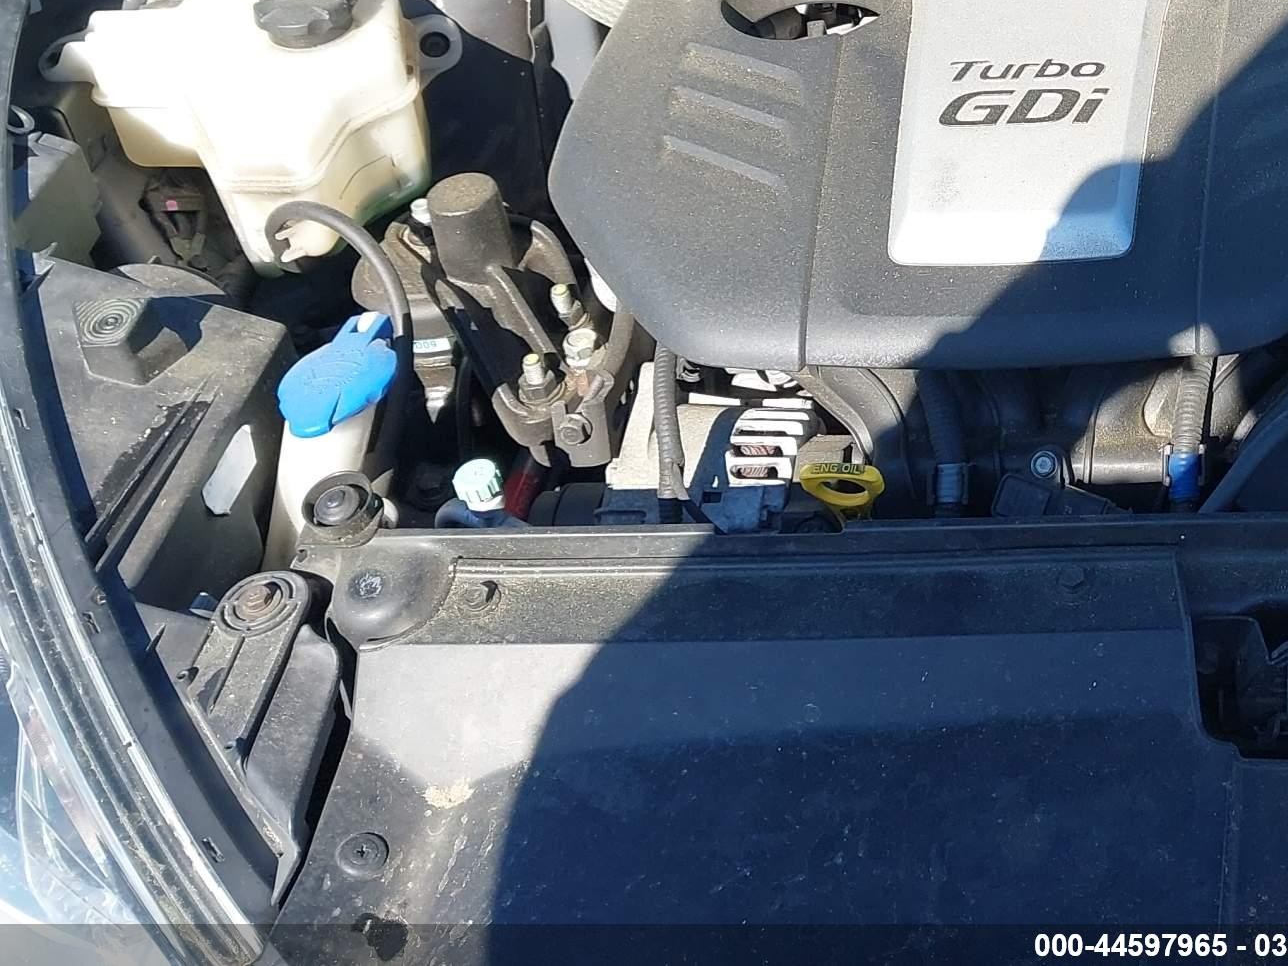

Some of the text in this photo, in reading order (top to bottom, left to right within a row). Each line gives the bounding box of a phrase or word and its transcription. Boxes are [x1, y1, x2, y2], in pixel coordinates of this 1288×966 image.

[950, 58, 1105, 82] Turbo
[938, 88, 1110, 126] GDi
[813, 463, 862, 474] ENG OIL
